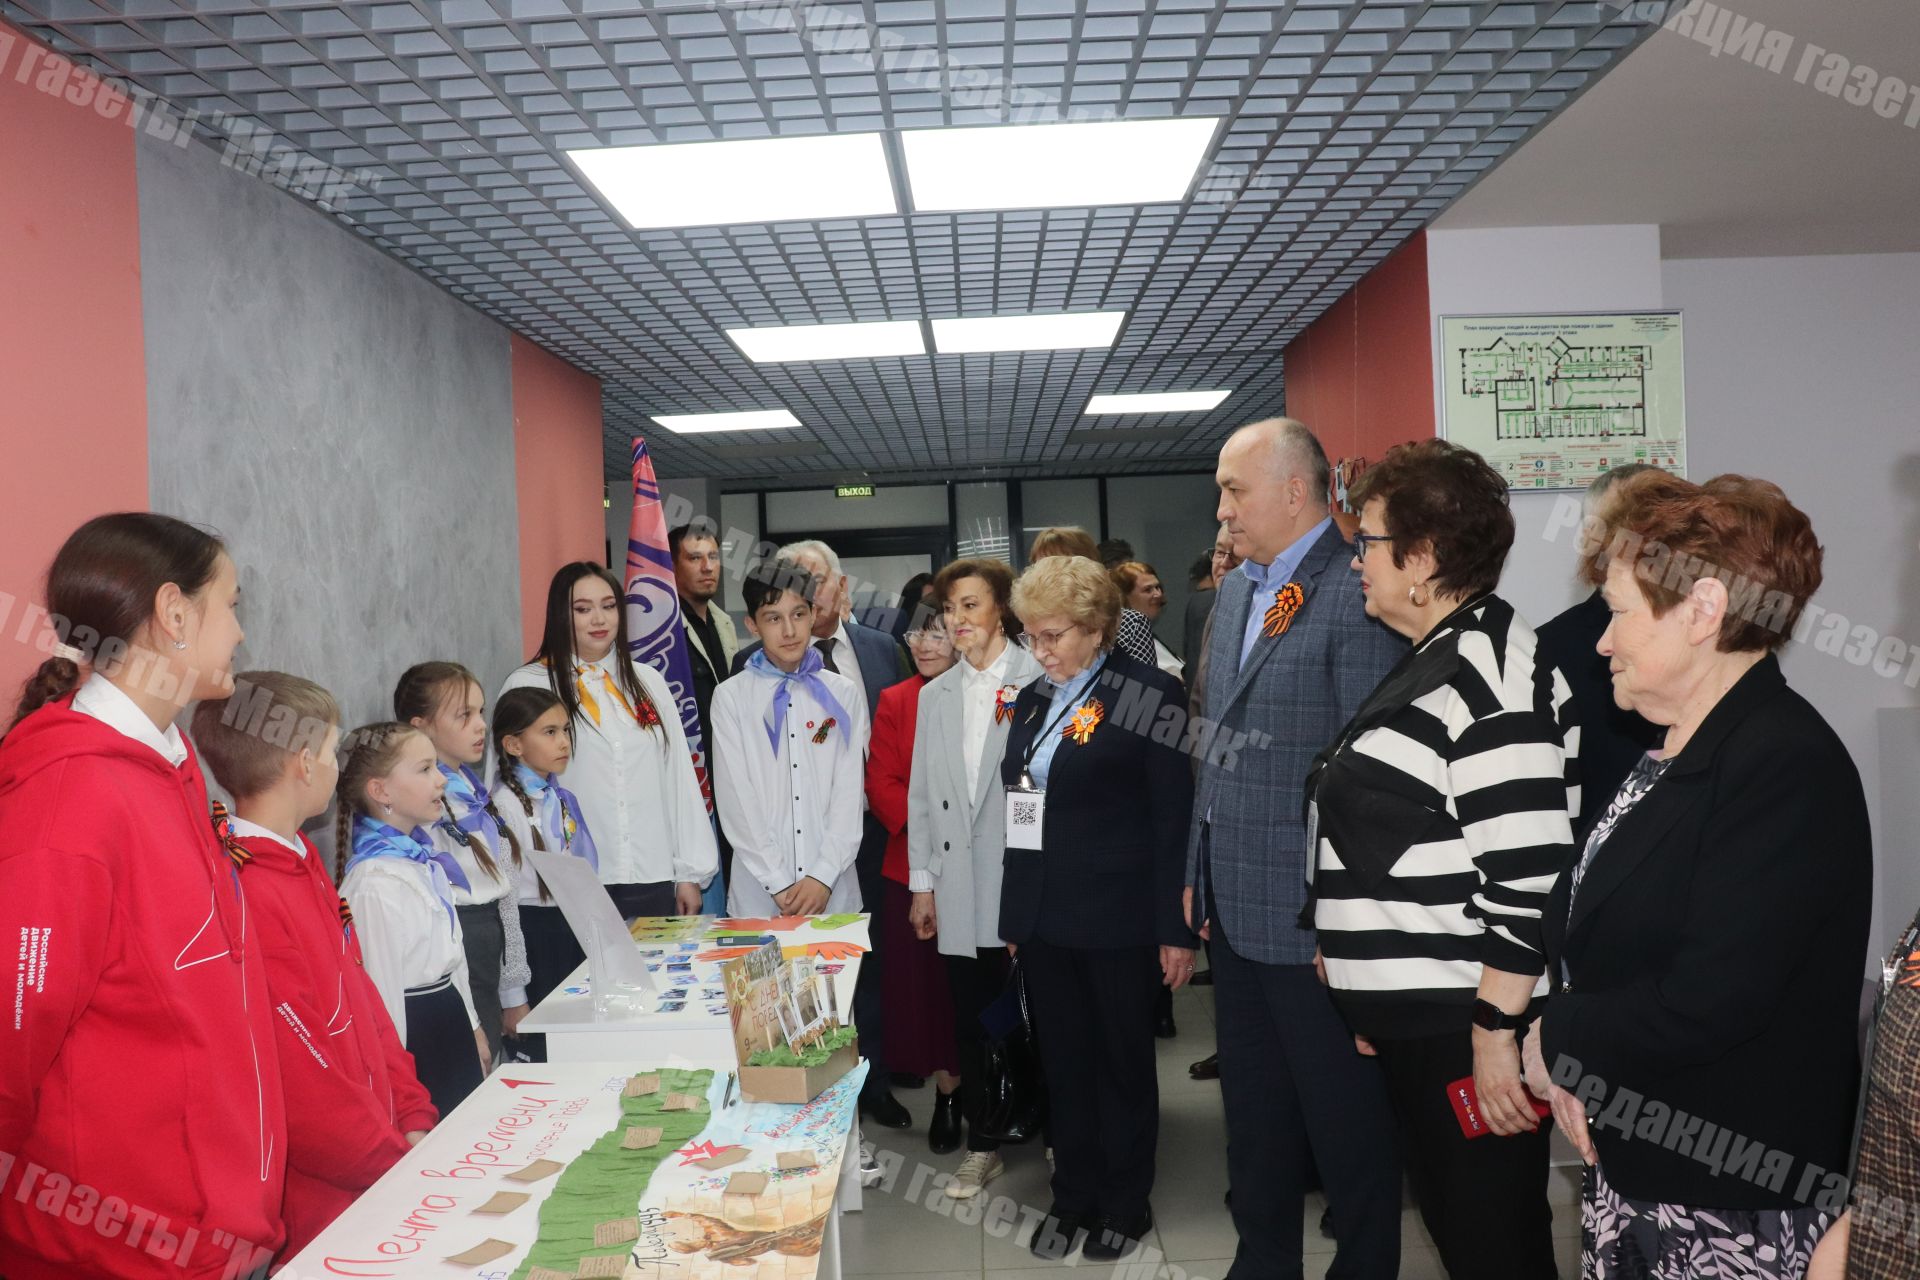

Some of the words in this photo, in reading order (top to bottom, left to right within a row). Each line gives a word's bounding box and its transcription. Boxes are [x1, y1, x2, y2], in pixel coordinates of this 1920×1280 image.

[1568, 461, 1573, 469] 3
[838, 486, 872, 497] ВЫХОД
[1508, 479, 1514, 487] 2
[1568, 478, 1573, 486] 3
[19, 926, 29, 961] детей
[18, 963, 25, 971] и
[27, 927, 39, 986] движение
[36, 927, 51, 993] Российское
[14, 973, 24, 1030] молодёжи
[276, 1006, 295, 1027] детей
[324, 1194, 464, 1277] Лента
[420, 1096, 559, 1180] времени
